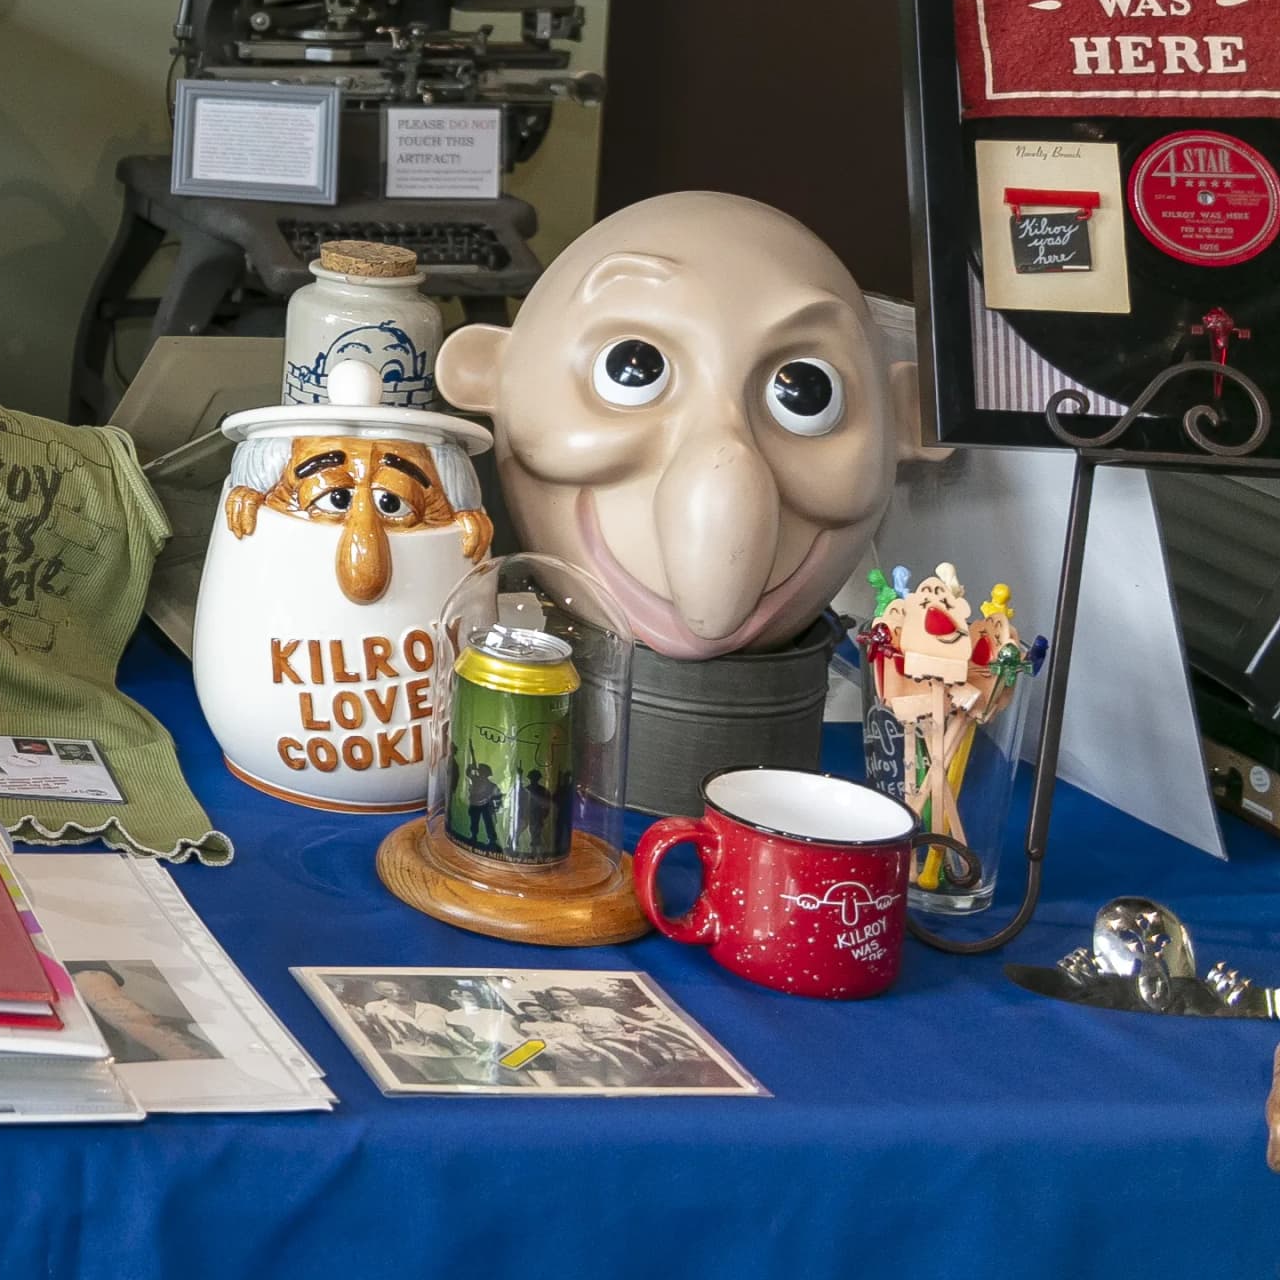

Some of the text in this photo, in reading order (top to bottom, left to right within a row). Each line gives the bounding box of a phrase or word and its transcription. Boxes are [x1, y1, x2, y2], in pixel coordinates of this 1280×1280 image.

[1069, 35, 1248, 76] HERE
[1183, 148, 1232, 173] STAR
[1018, 217, 1079, 245] Kilroy
[1033, 246, 1076, 264] here
[298, 677, 434, 732] LOVE
[277, 722, 424, 772] COOKI
[836, 916, 888, 950] KILROY
[851, 940, 880, 960] WAS
